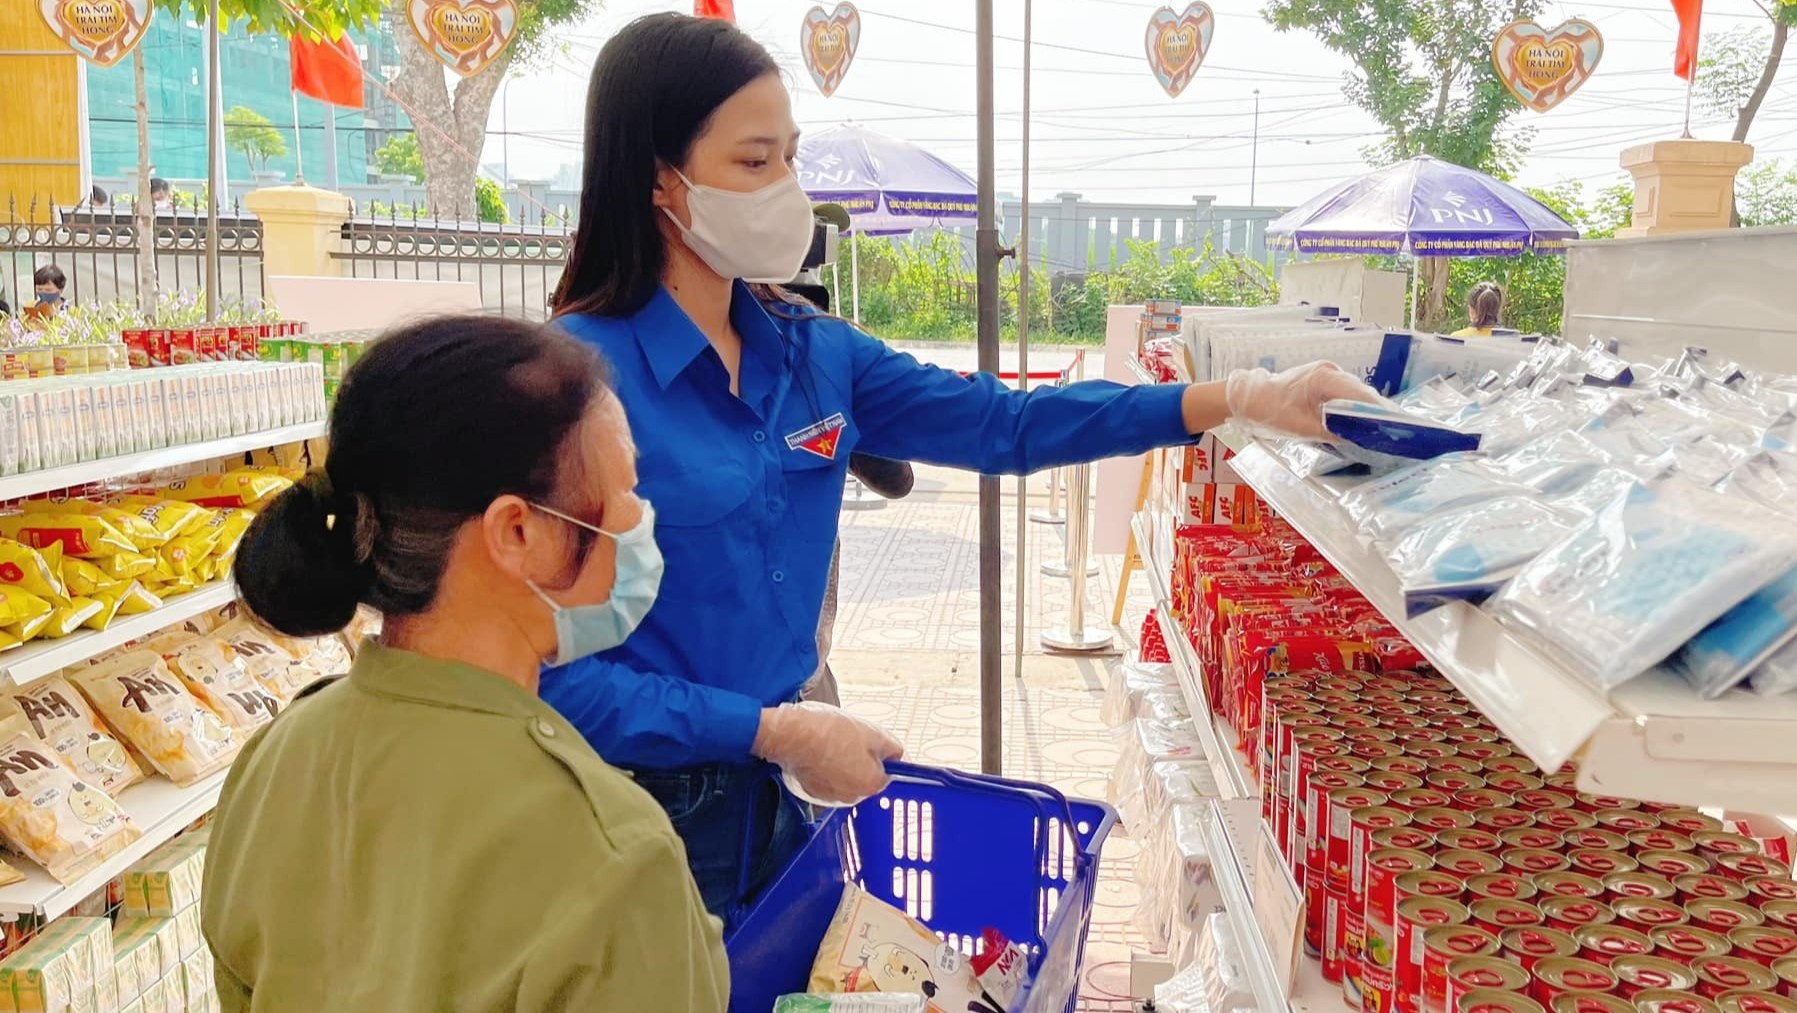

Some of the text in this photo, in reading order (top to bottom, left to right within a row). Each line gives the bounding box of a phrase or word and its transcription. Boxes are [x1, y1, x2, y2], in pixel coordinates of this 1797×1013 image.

[1431, 208, 1494, 225] PNJ
[1196, 448, 1208, 471] AFC
[1188, 495, 1201, 519] AFC
[1219, 496, 1231, 519] AFC
